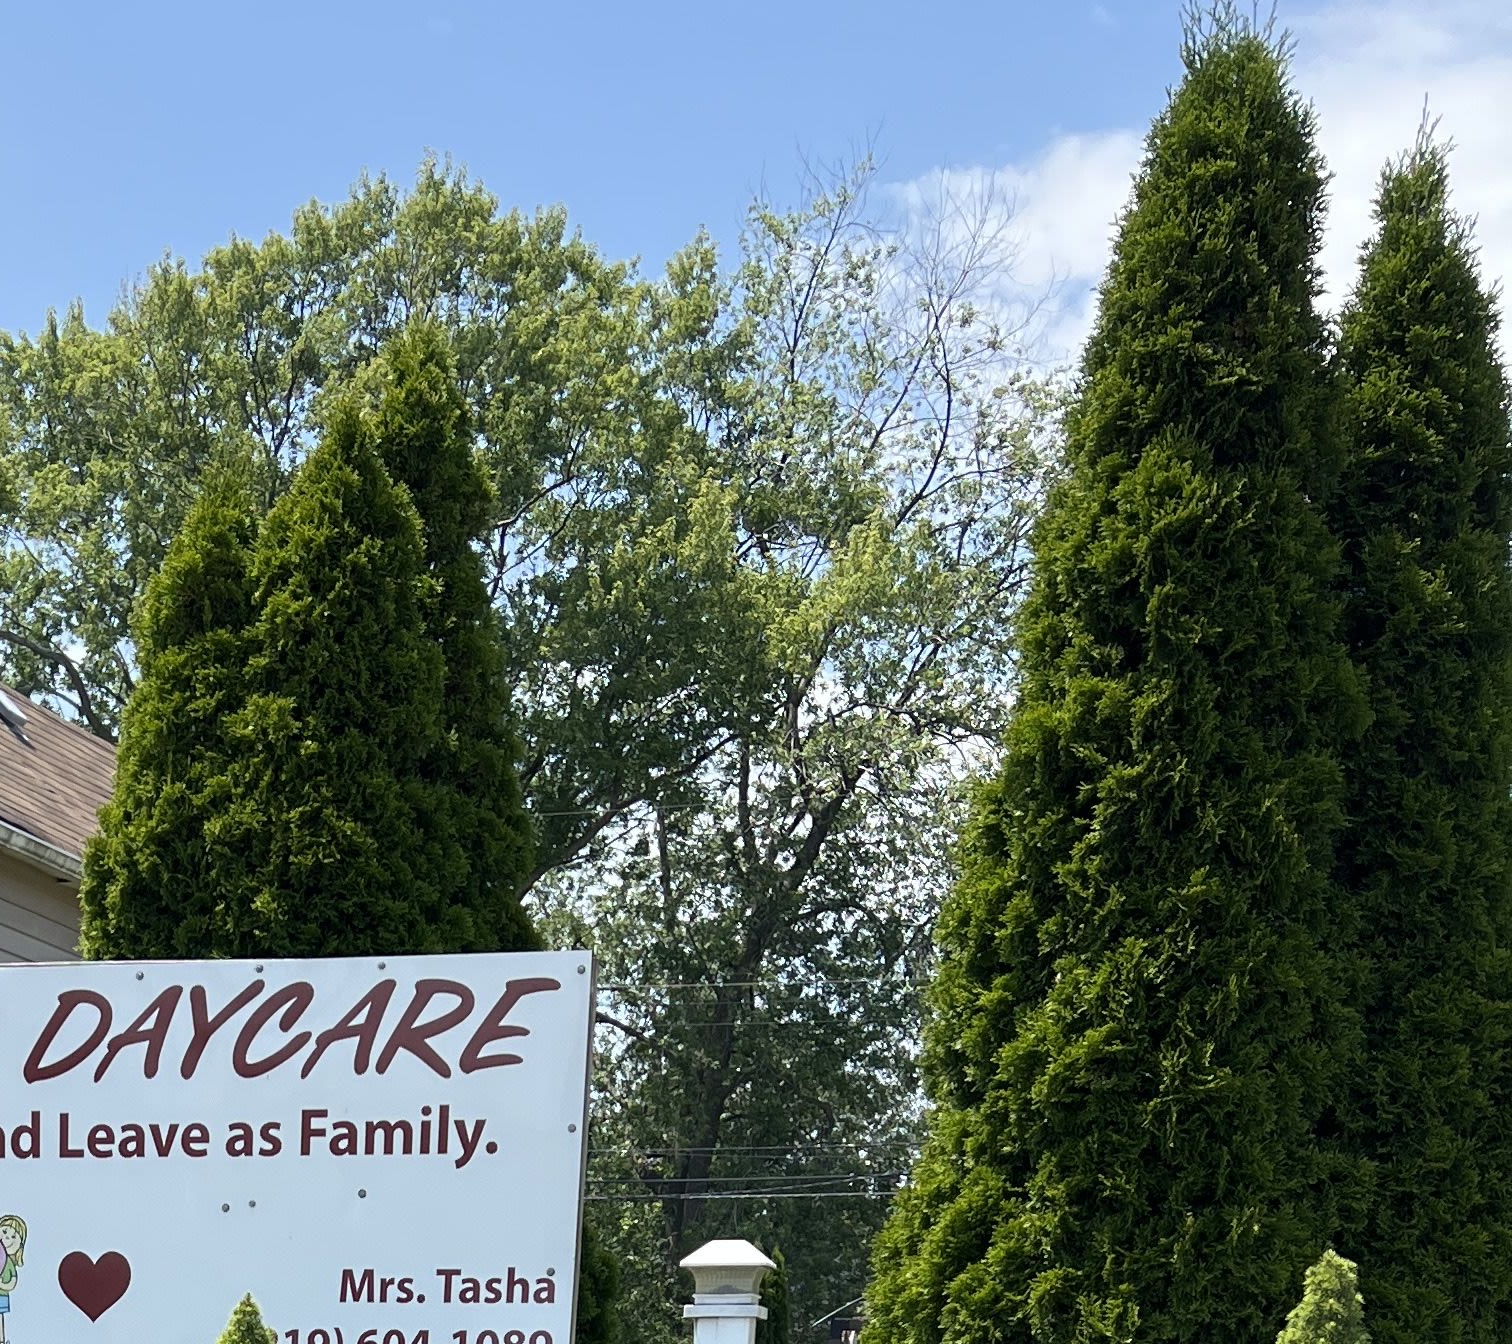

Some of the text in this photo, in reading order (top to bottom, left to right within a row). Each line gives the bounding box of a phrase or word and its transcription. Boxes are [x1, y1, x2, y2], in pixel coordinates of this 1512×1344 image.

[23, 977, 561, 1084] DAYCARE
[59, 1112, 210, 1159] Leave
[225, 1121, 282, 1158] as
[300, 1104, 498, 1170] Family.
[339, 1267, 556, 1304] Mrs. Tasha
